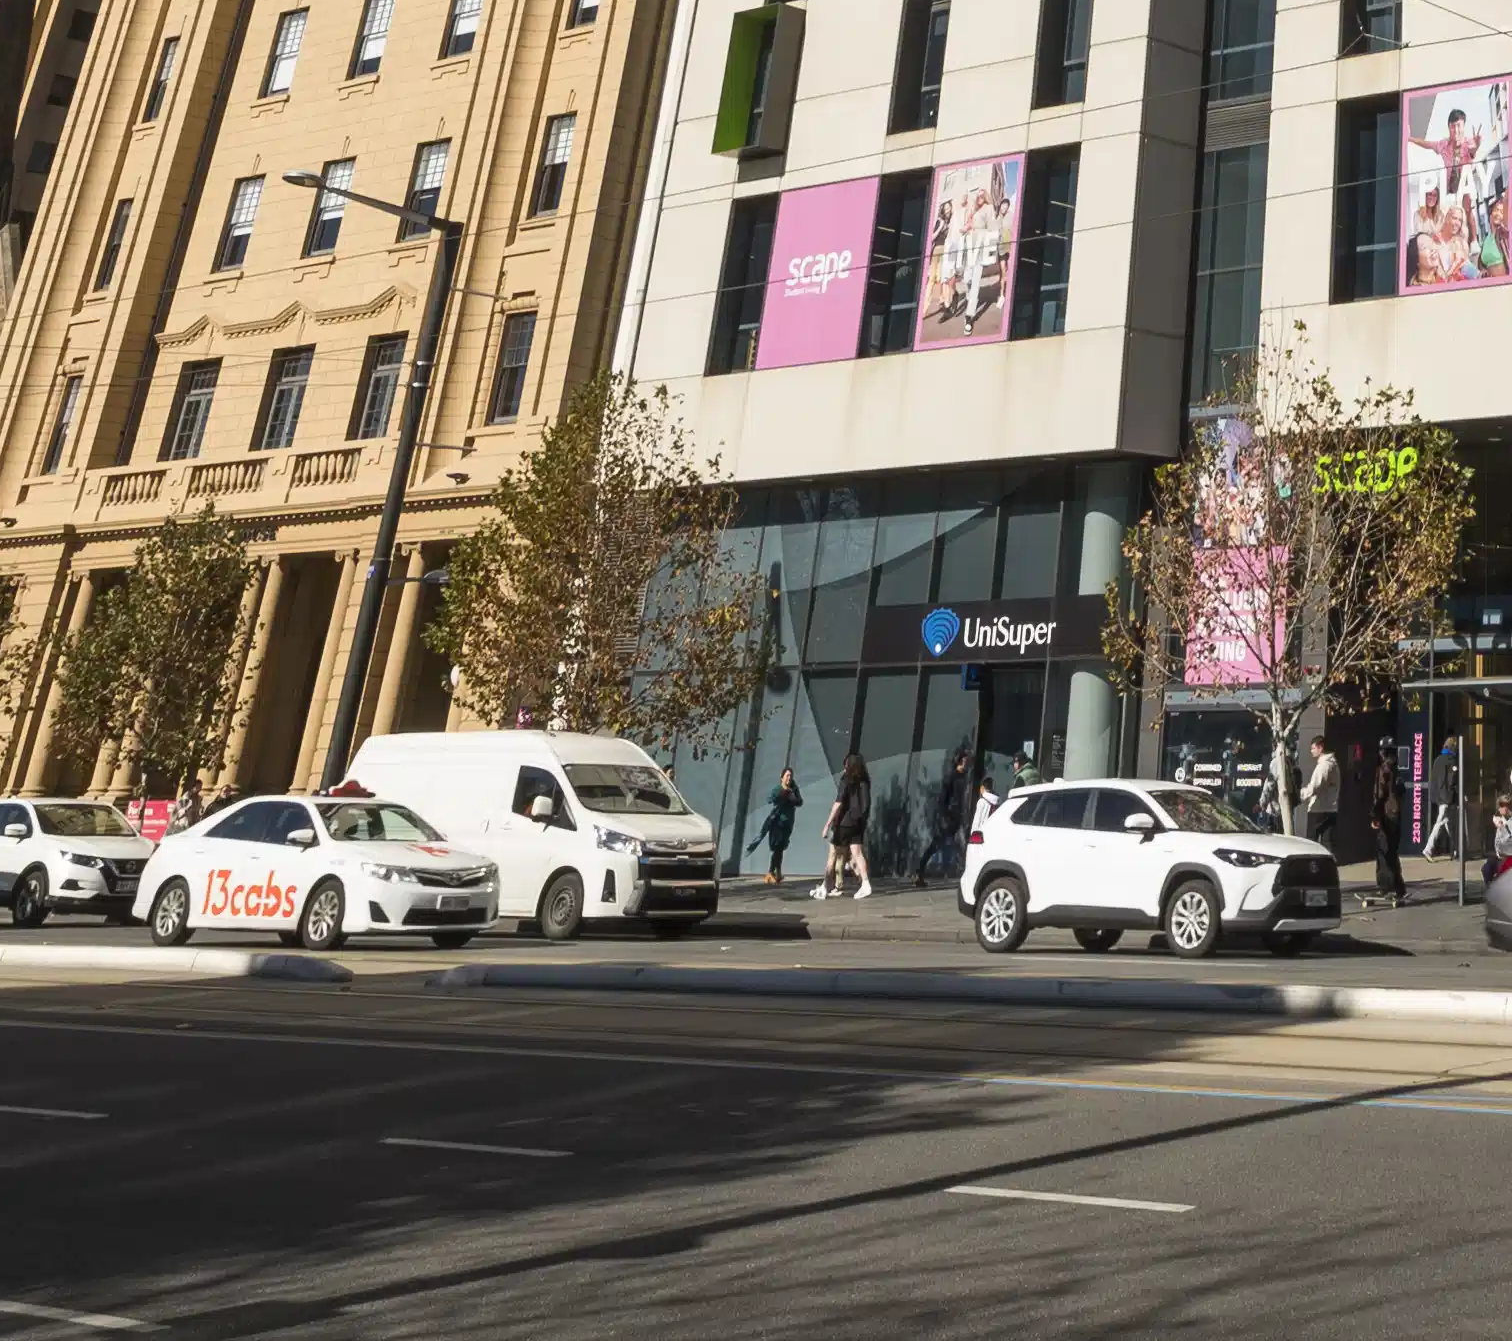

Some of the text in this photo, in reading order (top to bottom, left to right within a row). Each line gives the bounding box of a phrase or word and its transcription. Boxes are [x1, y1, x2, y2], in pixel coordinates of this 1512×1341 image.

[1417, 159, 1500, 200] PLAY
[785, 249, 852, 294] scape
[963, 616, 1056, 655] UniSuper
[1414, 732, 1424, 778] TERRACE
[1413, 780, 1422, 817] NORTH
[202, 868, 298, 918] 13cabs
